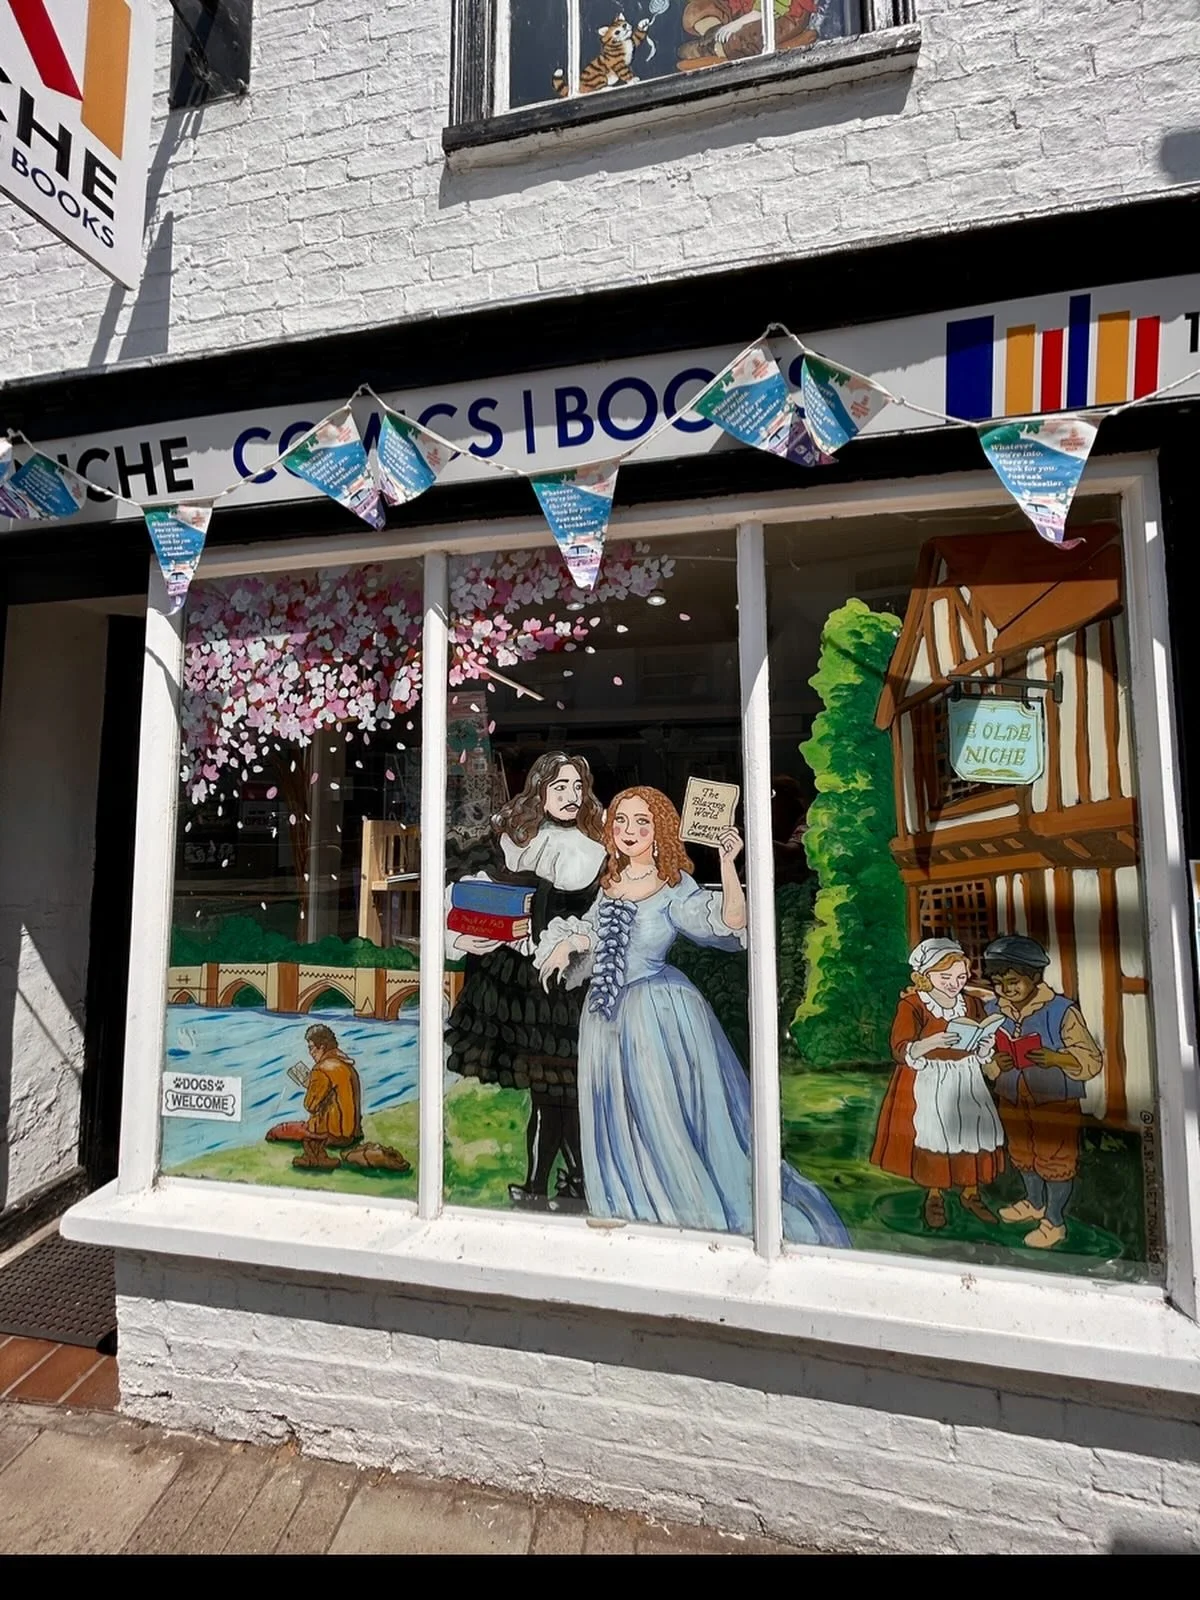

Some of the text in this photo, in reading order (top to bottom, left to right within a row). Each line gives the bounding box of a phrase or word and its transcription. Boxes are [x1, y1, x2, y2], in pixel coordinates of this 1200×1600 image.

[0, 66, 117, 222] HE
[11, 146, 115, 249] BOOKS
[13, 436, 195, 503] CHE
[233, 397, 504, 484] COCS
[554, 350, 827, 449] BOO
[982, 722, 1032, 742] OLDE
[965, 745, 1027, 766] NICHE
[702, 787, 720, 800] The
[694, 806, 719, 820] World
[183, 1078, 214, 1091] DOGS
[171, 1094, 229, 1110] WELCOME
